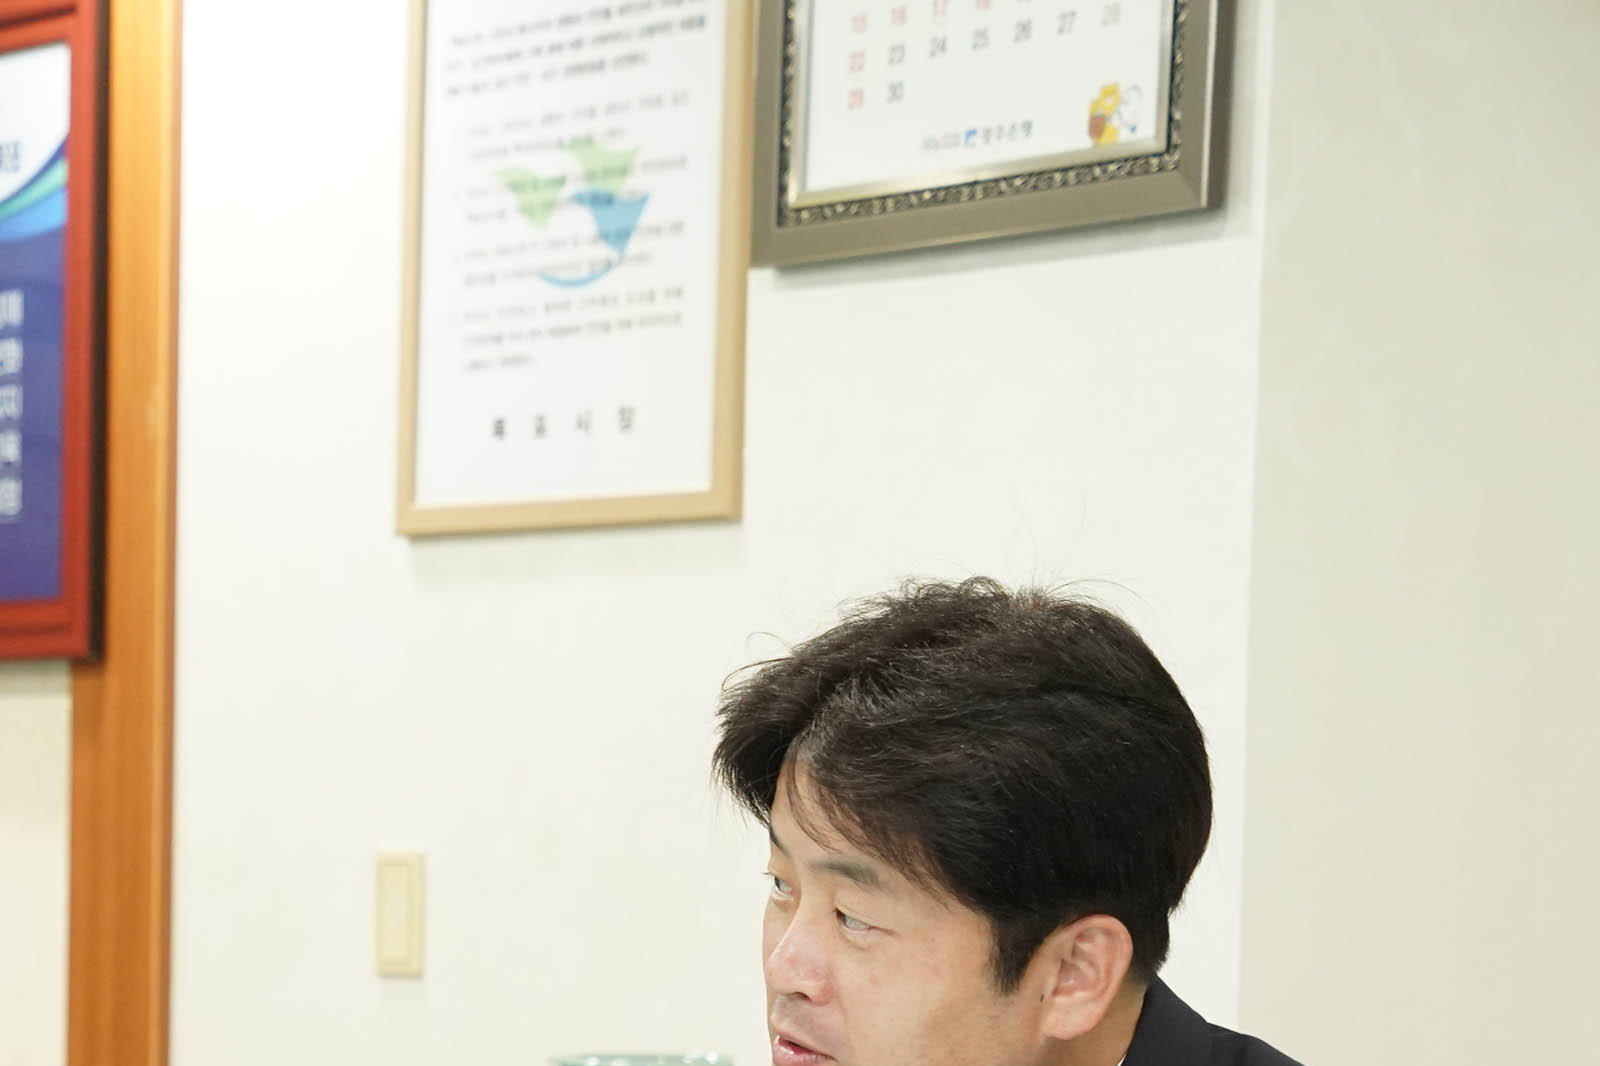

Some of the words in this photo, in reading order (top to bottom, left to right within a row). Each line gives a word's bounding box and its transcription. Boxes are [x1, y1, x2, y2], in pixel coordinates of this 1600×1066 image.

[887, 43, 906, 67] 23
[929, 36, 948, 59] 24
[971, 26, 990, 51] 25
[1013, 17, 1032, 44] 26
[1057, 9, 1078, 35] 27
[886, 81, 904, 104] 30
